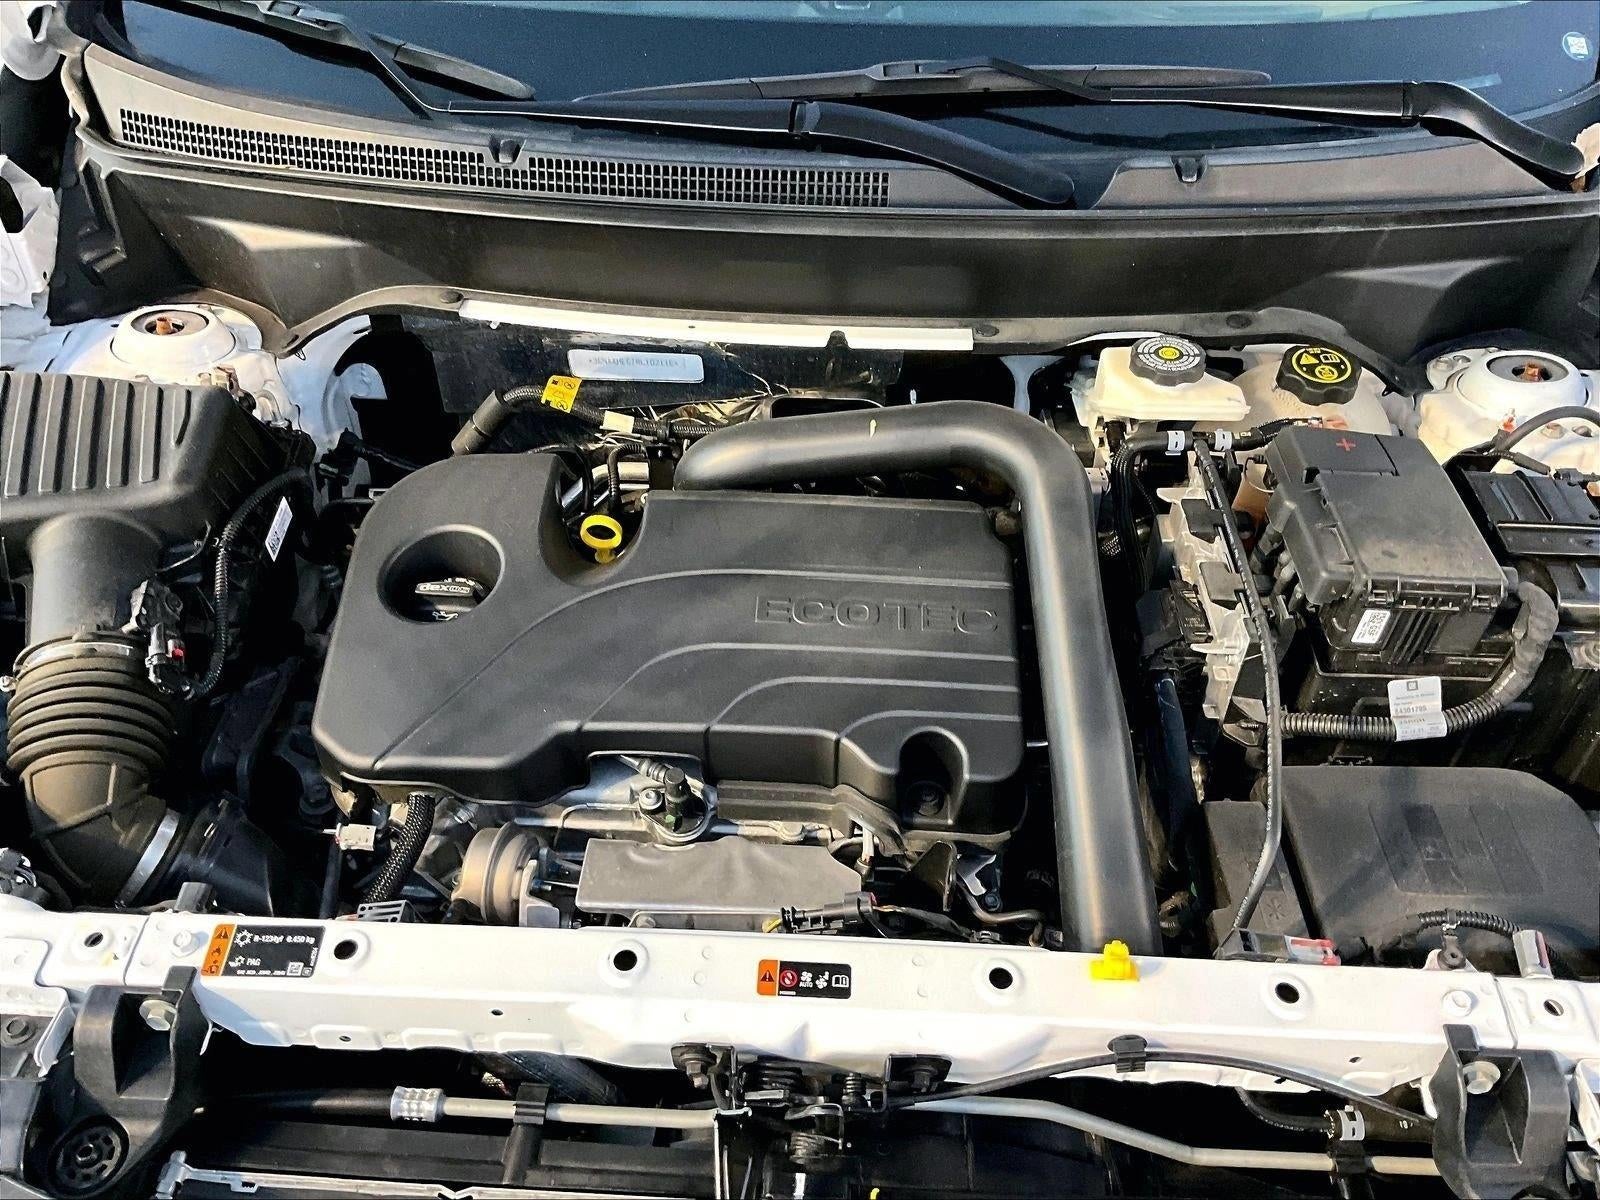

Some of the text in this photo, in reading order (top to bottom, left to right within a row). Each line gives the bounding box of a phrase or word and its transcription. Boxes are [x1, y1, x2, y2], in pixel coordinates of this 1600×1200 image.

[420, 583, 470, 593] dexos
[755, 596, 998, 635] ECOTEC
[253, 935, 316, 944] R-1234yf 0.450 kg
[246, 958, 261, 967] PAG
